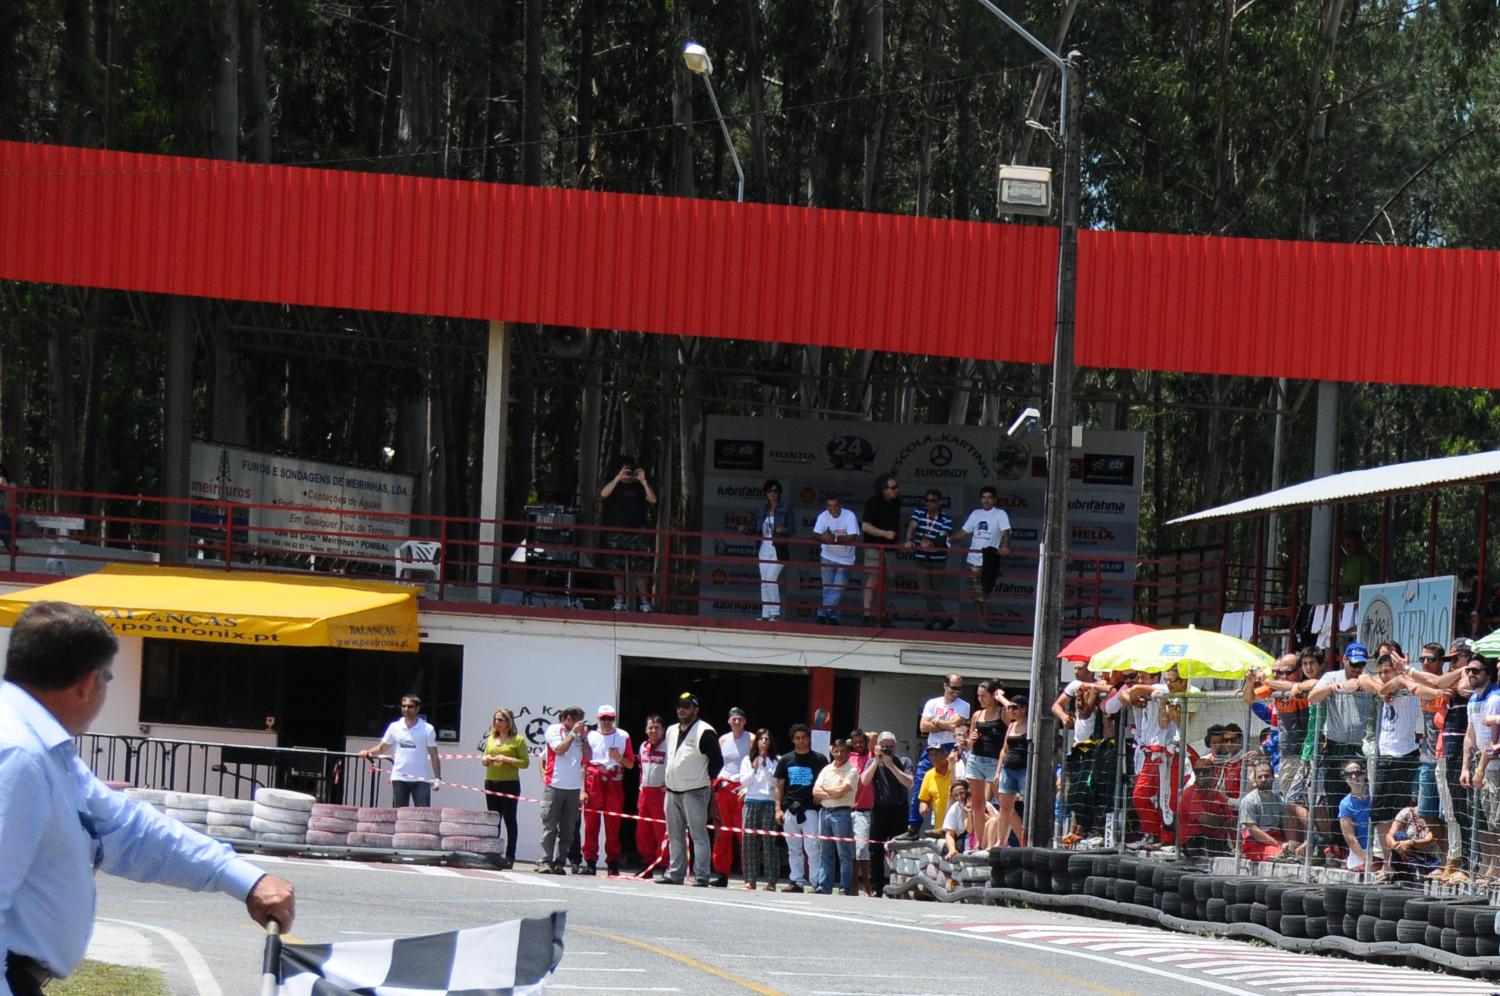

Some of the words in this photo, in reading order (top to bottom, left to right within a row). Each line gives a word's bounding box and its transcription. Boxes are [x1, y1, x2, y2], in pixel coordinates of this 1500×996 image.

[833, 438, 861, 456] 24
[769, 450, 817, 460] HONDA
[941, 434, 990, 478] KARTING
[241, 460, 271, 475] FUROS
[272, 467, 278, 477] E
[280, 468, 331, 485] SONDAGENS
[333, 477, 344, 487] DE
[914, 467, 968, 479] EUROINDY
[304, 515, 338, 529] Qualquer
[360, 541, 390, 552] POMBAL
